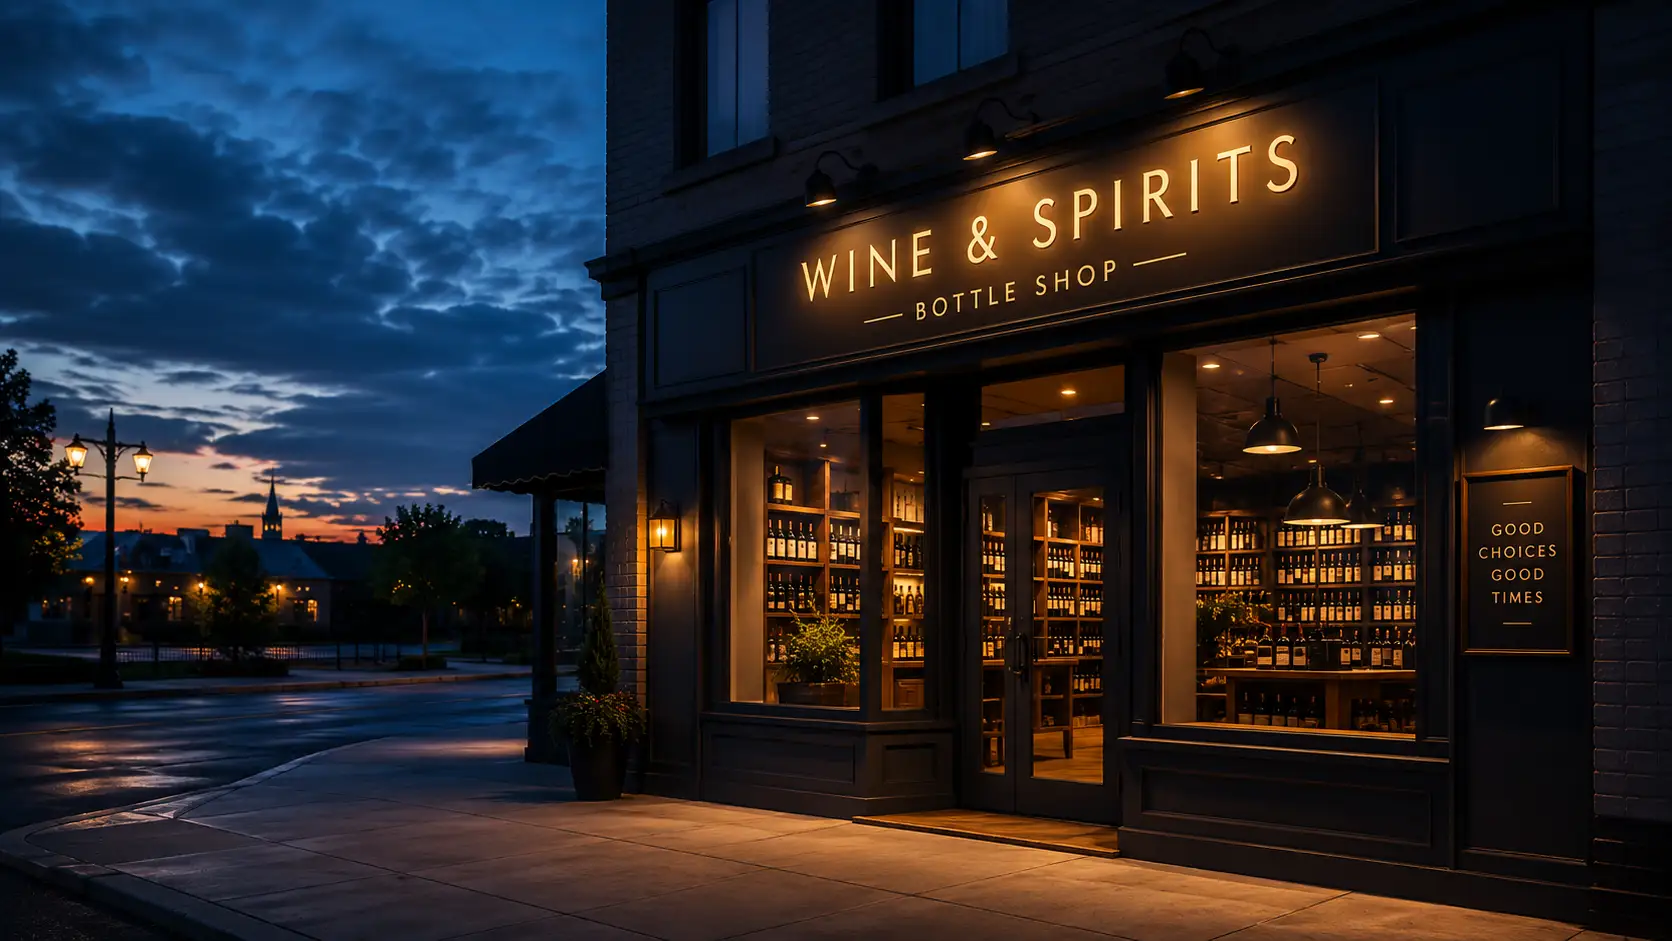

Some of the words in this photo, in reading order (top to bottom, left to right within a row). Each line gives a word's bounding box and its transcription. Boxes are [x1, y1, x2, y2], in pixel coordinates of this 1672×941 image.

[801, 229, 933, 302] WINE
[967, 214, 999, 265] &
[1032, 134, 1299, 248] SPIRITS
[915, 285, 1017, 322] BOTTLE
[1035, 259, 1117, 297] SHOP
[1491, 522, 1544, 536] GOOD
[1478, 544, 1557, 560] CHOICES
[1491, 568, 1545, 582] GOOD
[1491, 591, 1544, 604] TIMES
